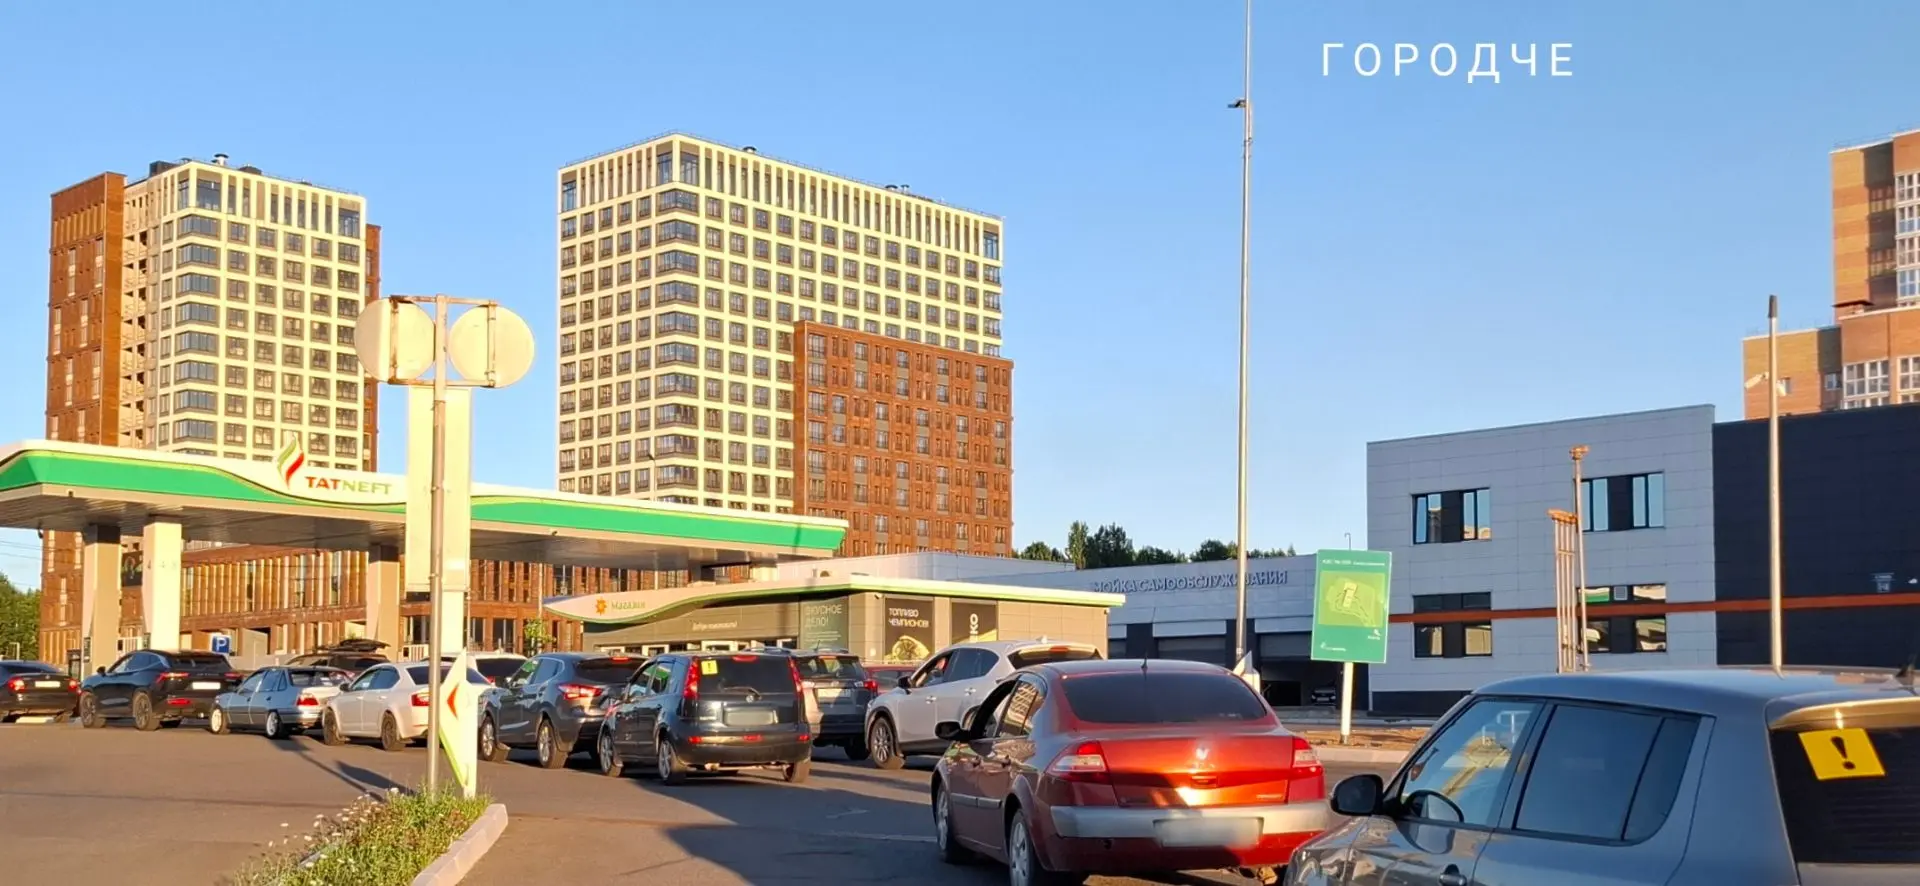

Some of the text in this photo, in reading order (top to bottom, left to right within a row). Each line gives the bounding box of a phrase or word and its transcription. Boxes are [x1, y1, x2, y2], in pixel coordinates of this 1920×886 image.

[304, 476, 392, 495] TATNEFT
[1093, 577, 1137, 593] МОЙКА
[888, 607, 919, 618] ТОПЛИВО
